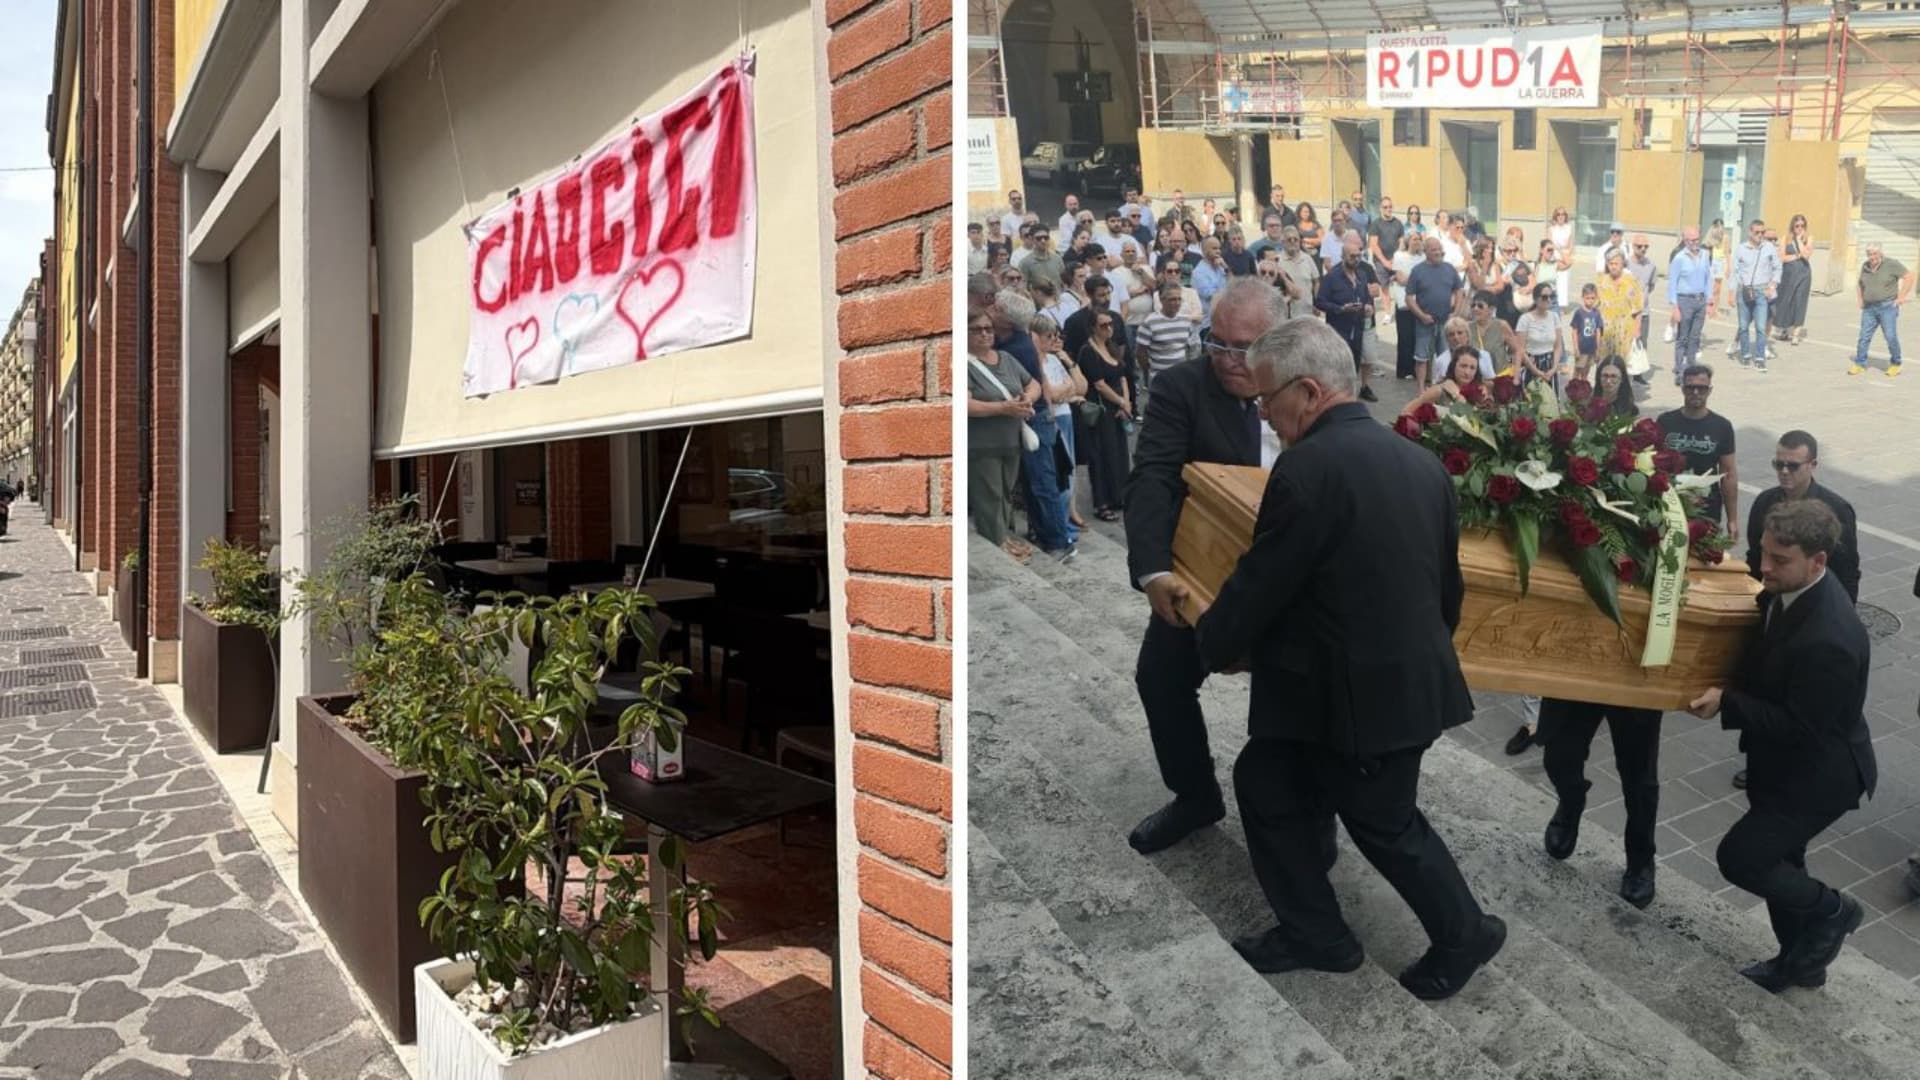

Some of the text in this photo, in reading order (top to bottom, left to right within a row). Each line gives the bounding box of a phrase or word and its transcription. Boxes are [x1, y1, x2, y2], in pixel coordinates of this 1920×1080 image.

[1379, 37, 1418, 48] QUESTA
[1378, 45, 1583, 88] R1PUD1A
[1518, 87, 1585, 99] LA GUERRA
[1655, 612, 1671, 628] LA
